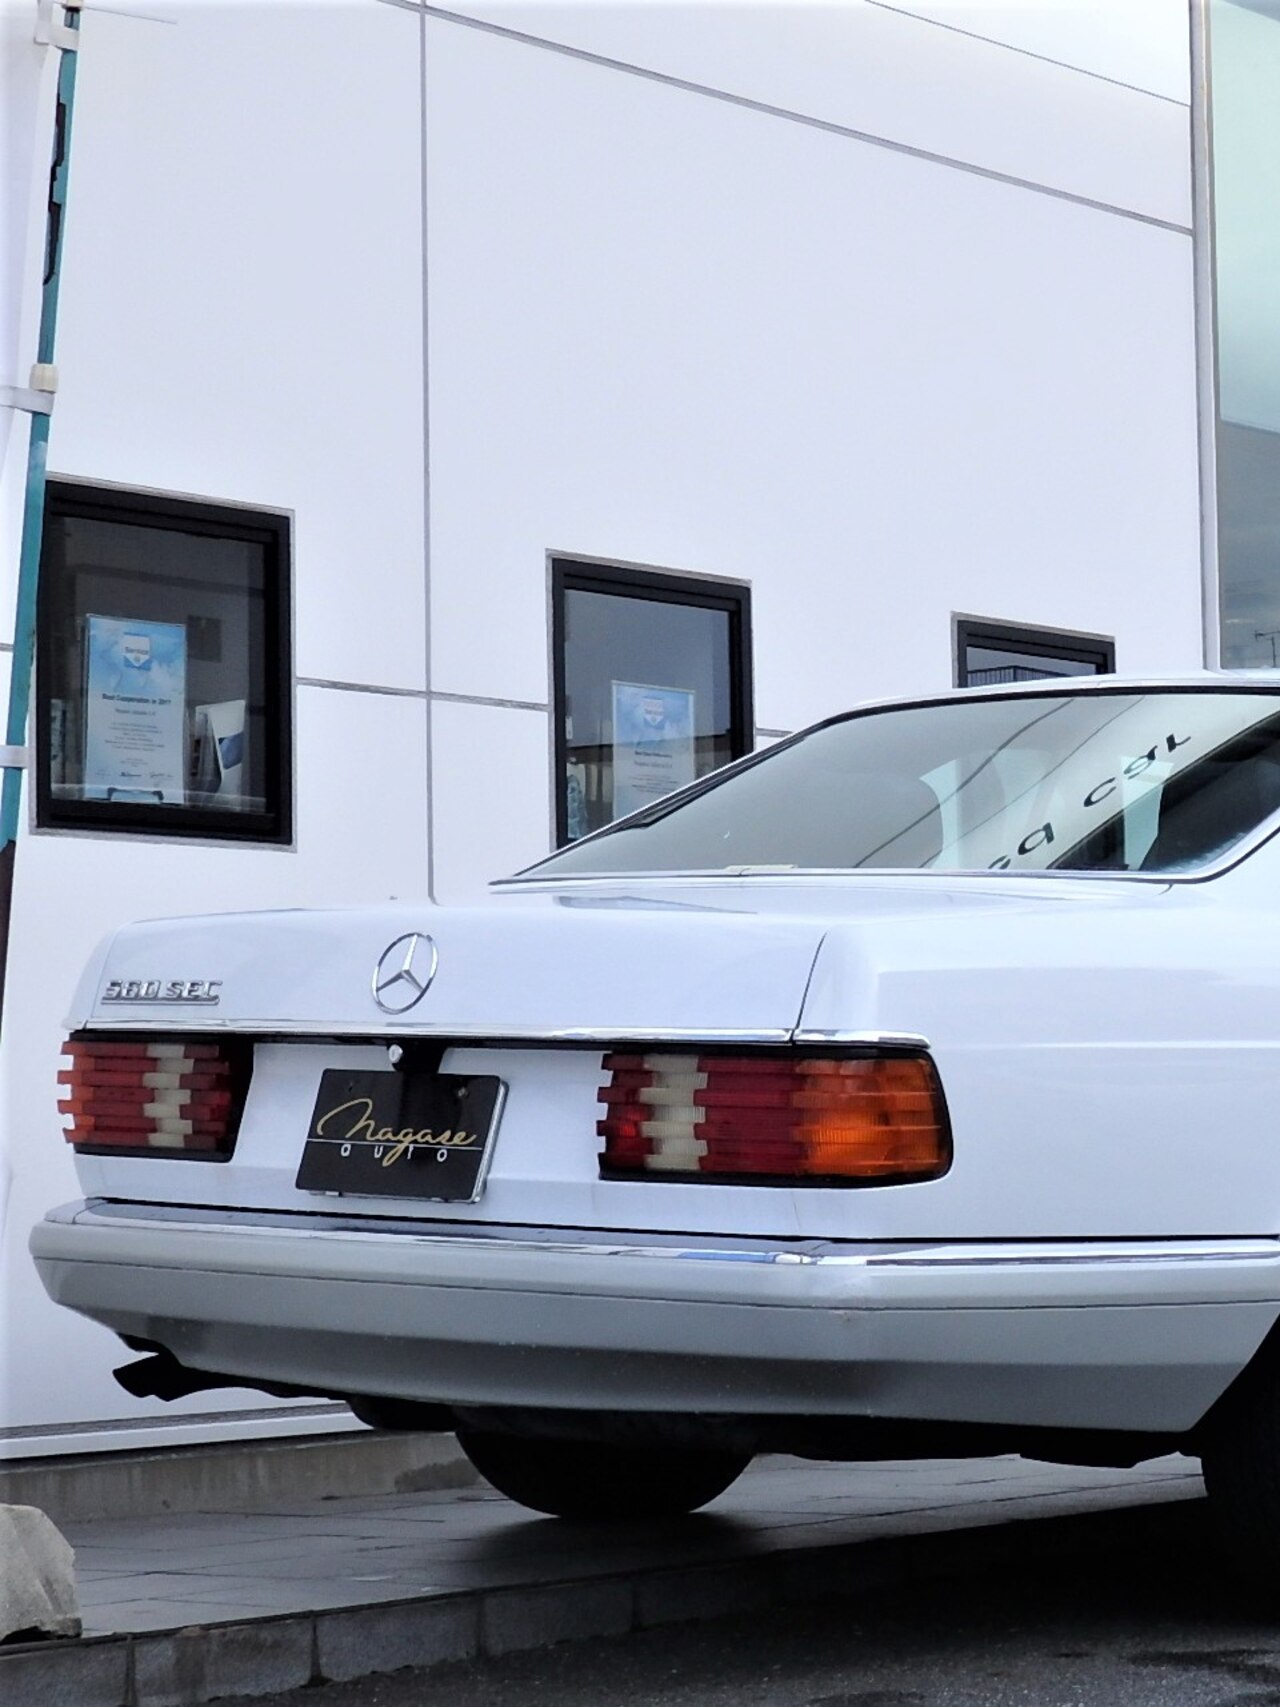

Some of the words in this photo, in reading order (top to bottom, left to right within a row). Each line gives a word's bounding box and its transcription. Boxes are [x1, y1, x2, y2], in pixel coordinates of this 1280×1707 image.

[103, 980, 161, 1001] 560
[163, 980, 223, 1001] SEC
[317, 1098, 477, 1167] Nagase
